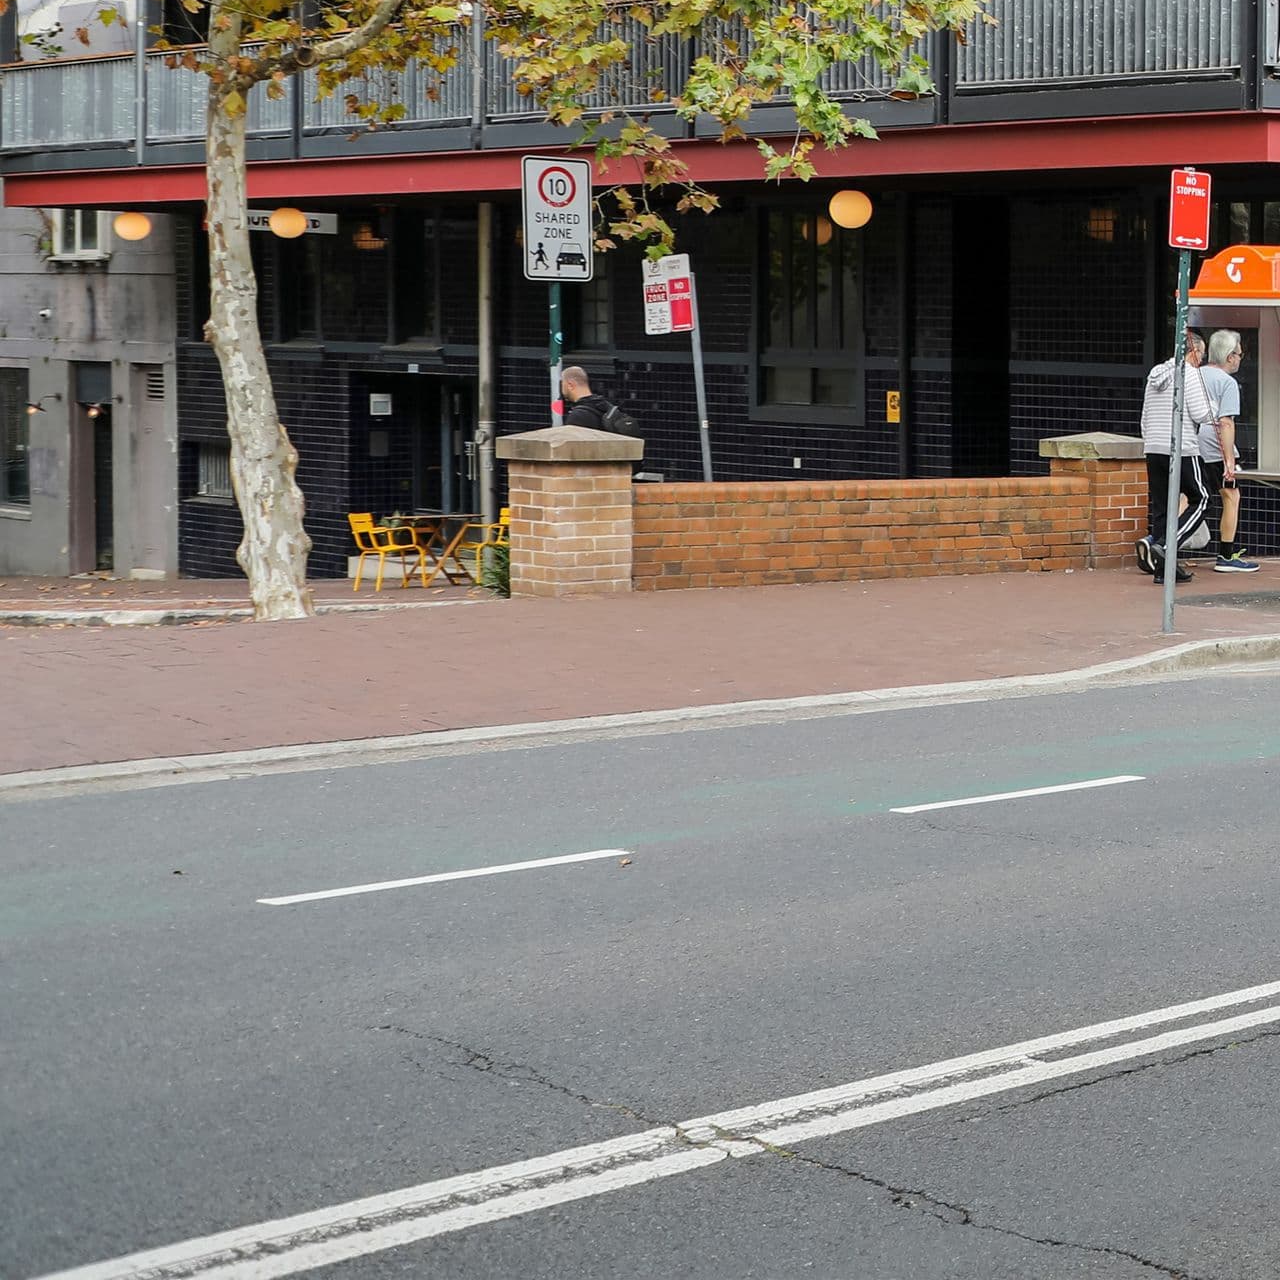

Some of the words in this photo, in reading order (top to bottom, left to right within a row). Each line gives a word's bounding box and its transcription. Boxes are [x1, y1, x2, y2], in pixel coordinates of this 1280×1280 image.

[549, 178, 567, 196] 10
[1185, 177, 1197, 186] NO
[1176, 185, 1206, 198] STOPPING
[535, 211, 581, 225] SHARED
[543, 227, 573, 239] ZONE
